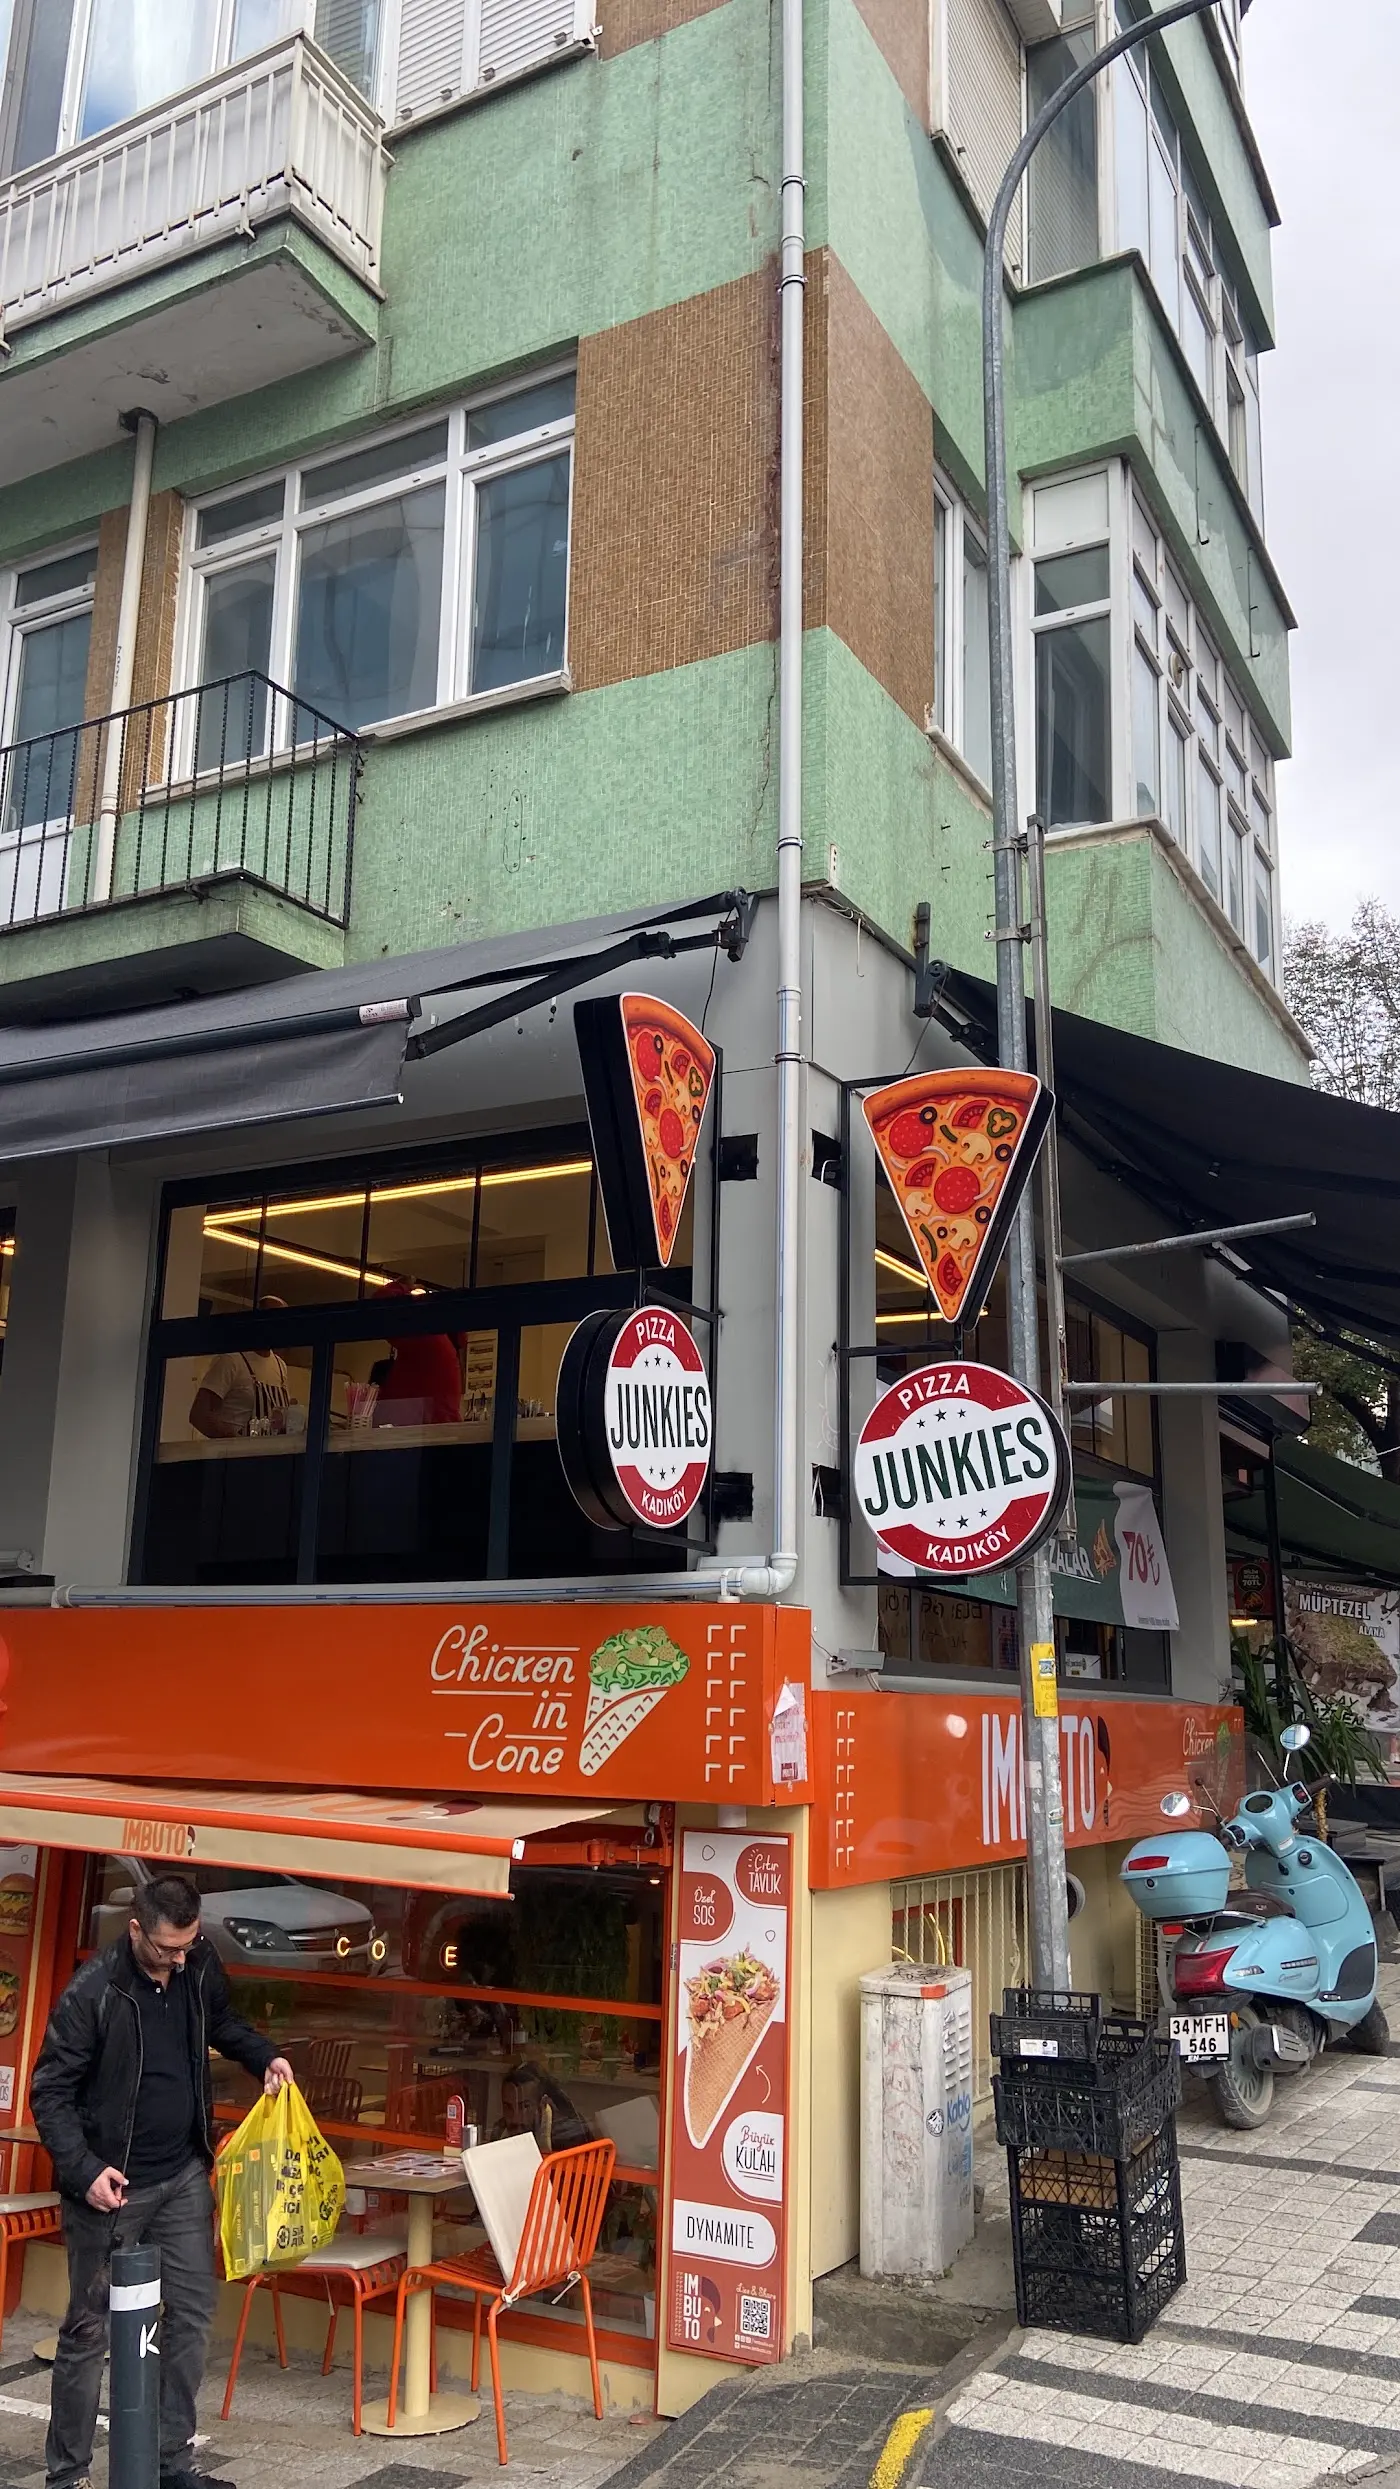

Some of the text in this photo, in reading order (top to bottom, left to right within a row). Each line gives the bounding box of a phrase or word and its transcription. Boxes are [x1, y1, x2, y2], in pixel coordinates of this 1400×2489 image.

[635, 1317, 675, 1347] PIZZA
[897, 1373, 971, 1410] PIZZA
[610, 1383, 708, 1450] JUNKIES
[864, 1417, 1049, 1516] JUNKIES
[641, 1486, 687, 1517] KADIKÖY
[925, 1524, 1012, 1564] KADIKÖY
[1300, 1592, 1370, 1620] MÜPTEZEL
[1358, 1625, 1385, 1638] ALANA
[430, 1624, 576, 1683] Chicken
[532, 1690, 568, 1729] in
[468, 1713, 565, 1774] Cone
[1182, 1717, 1215, 1757] Chicken
[981, 1713, 1096, 1845] IMTO
[122, 1819, 186, 1855] IMBUTO
[755, 1853, 779, 1872] Çıtır
[694, 1886, 716, 1904] Özel
[748, 1872, 781, 1894] TAVUK
[693, 1905, 715, 1926] SOS
[1173, 2017, 1225, 2034] 34 MFH
[1190, 2038, 1216, 2053] 546
[946, 2091, 970, 2127] Kablo
[740, 2125, 775, 2152] Büyük
[735, 2145, 775, 2174] KÜLAH
[687, 2215, 754, 2249] DYNAMITE
[683, 2272, 699, 2296] IM
[683, 2296, 701, 2318] BU
[140, 2321, 161, 2359] K
[683, 2317, 701, 2341] TO
